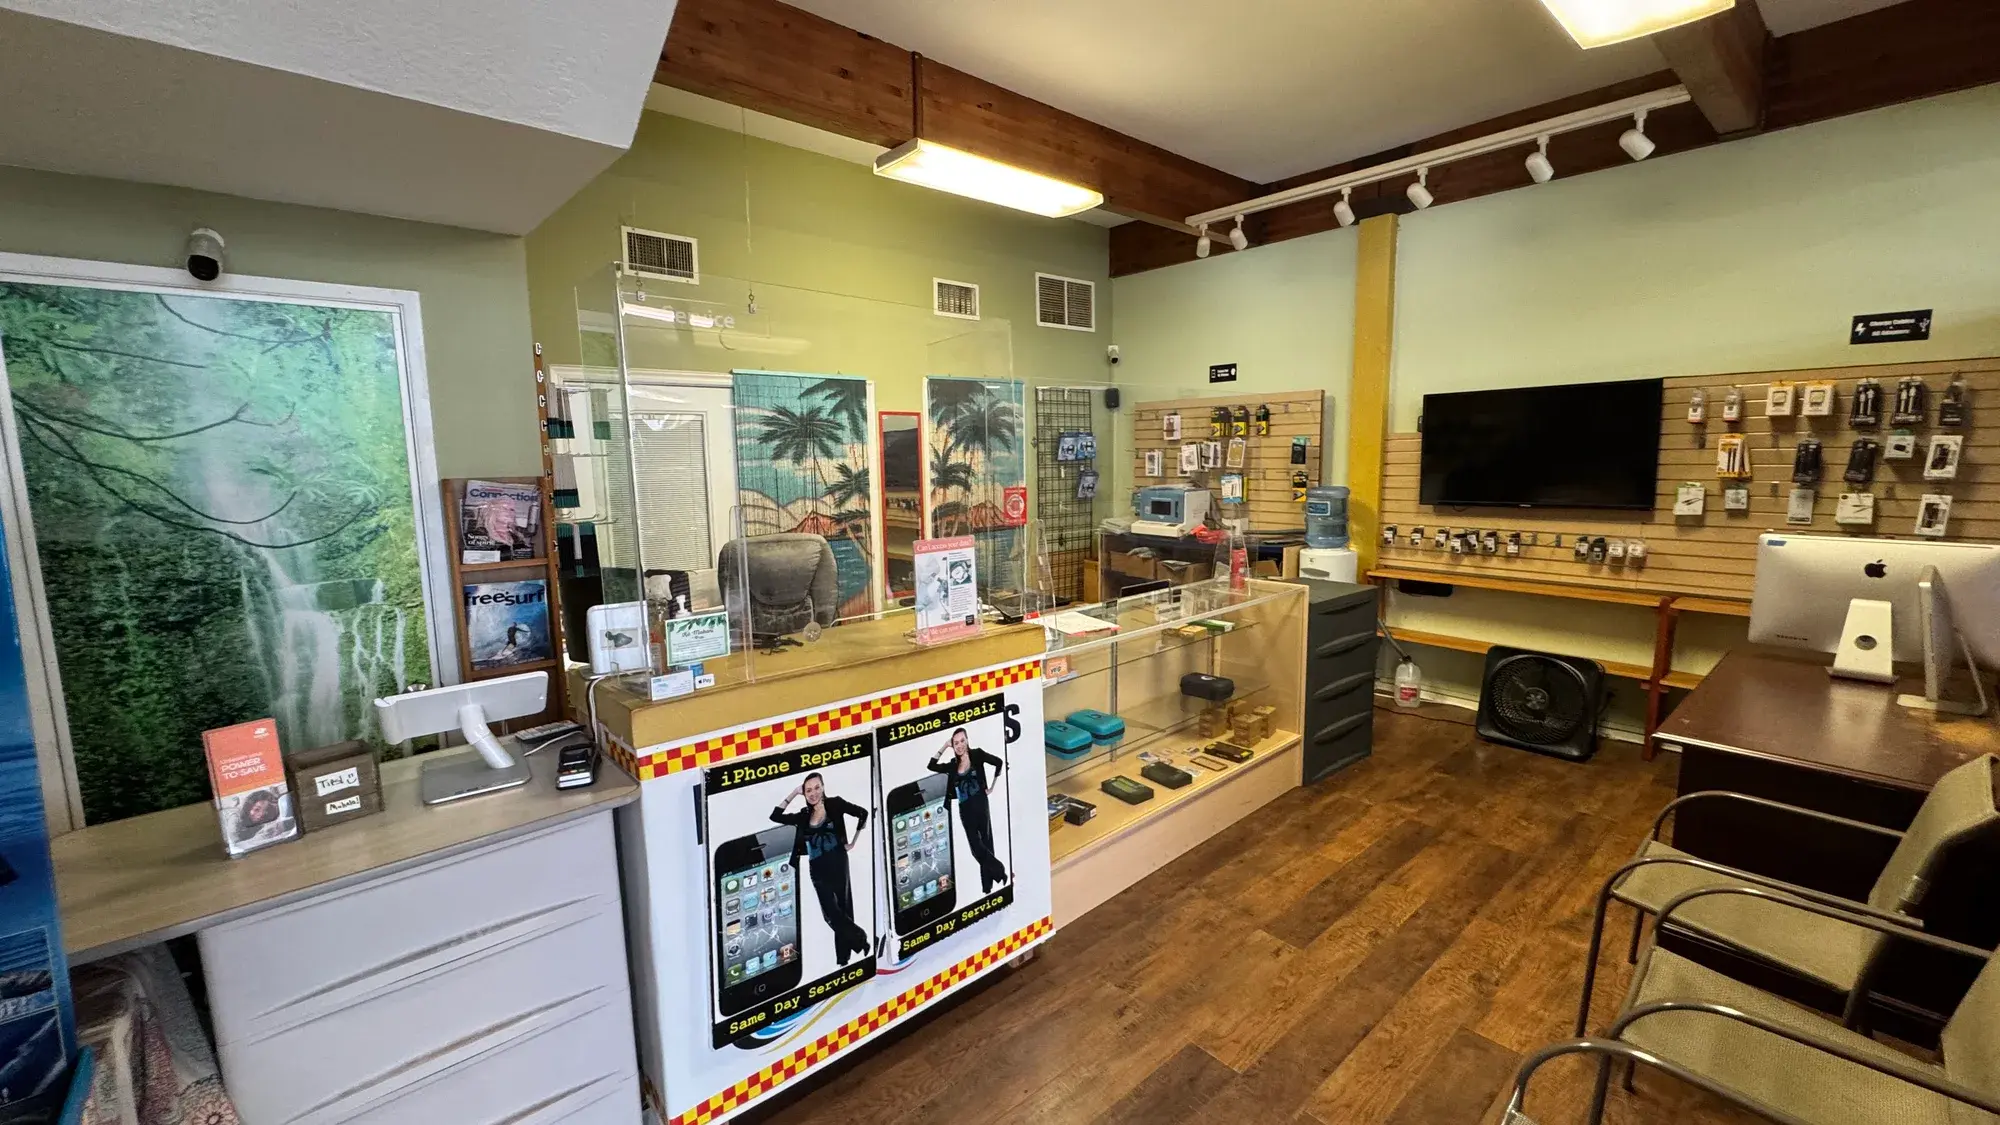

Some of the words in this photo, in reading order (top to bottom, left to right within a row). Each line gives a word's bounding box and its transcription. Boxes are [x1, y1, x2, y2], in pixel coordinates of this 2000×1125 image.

[889, 718, 942, 741] iPhone
[948, 702, 996, 724] Repair
[221, 757, 261, 772] POWER
[222, 771, 239, 780] TO
[240, 763, 267, 776] SAVE
[721, 760, 790, 787] iPhone
[800, 743, 861, 767] Repair
[903, 932, 931, 951] Same
[936, 919, 956, 935] Day
[961, 895, 1003, 921] Service
[729, 1011, 766, 1035] Same
[774, 995, 801, 1015] Day
[808, 967, 864, 998] Service
